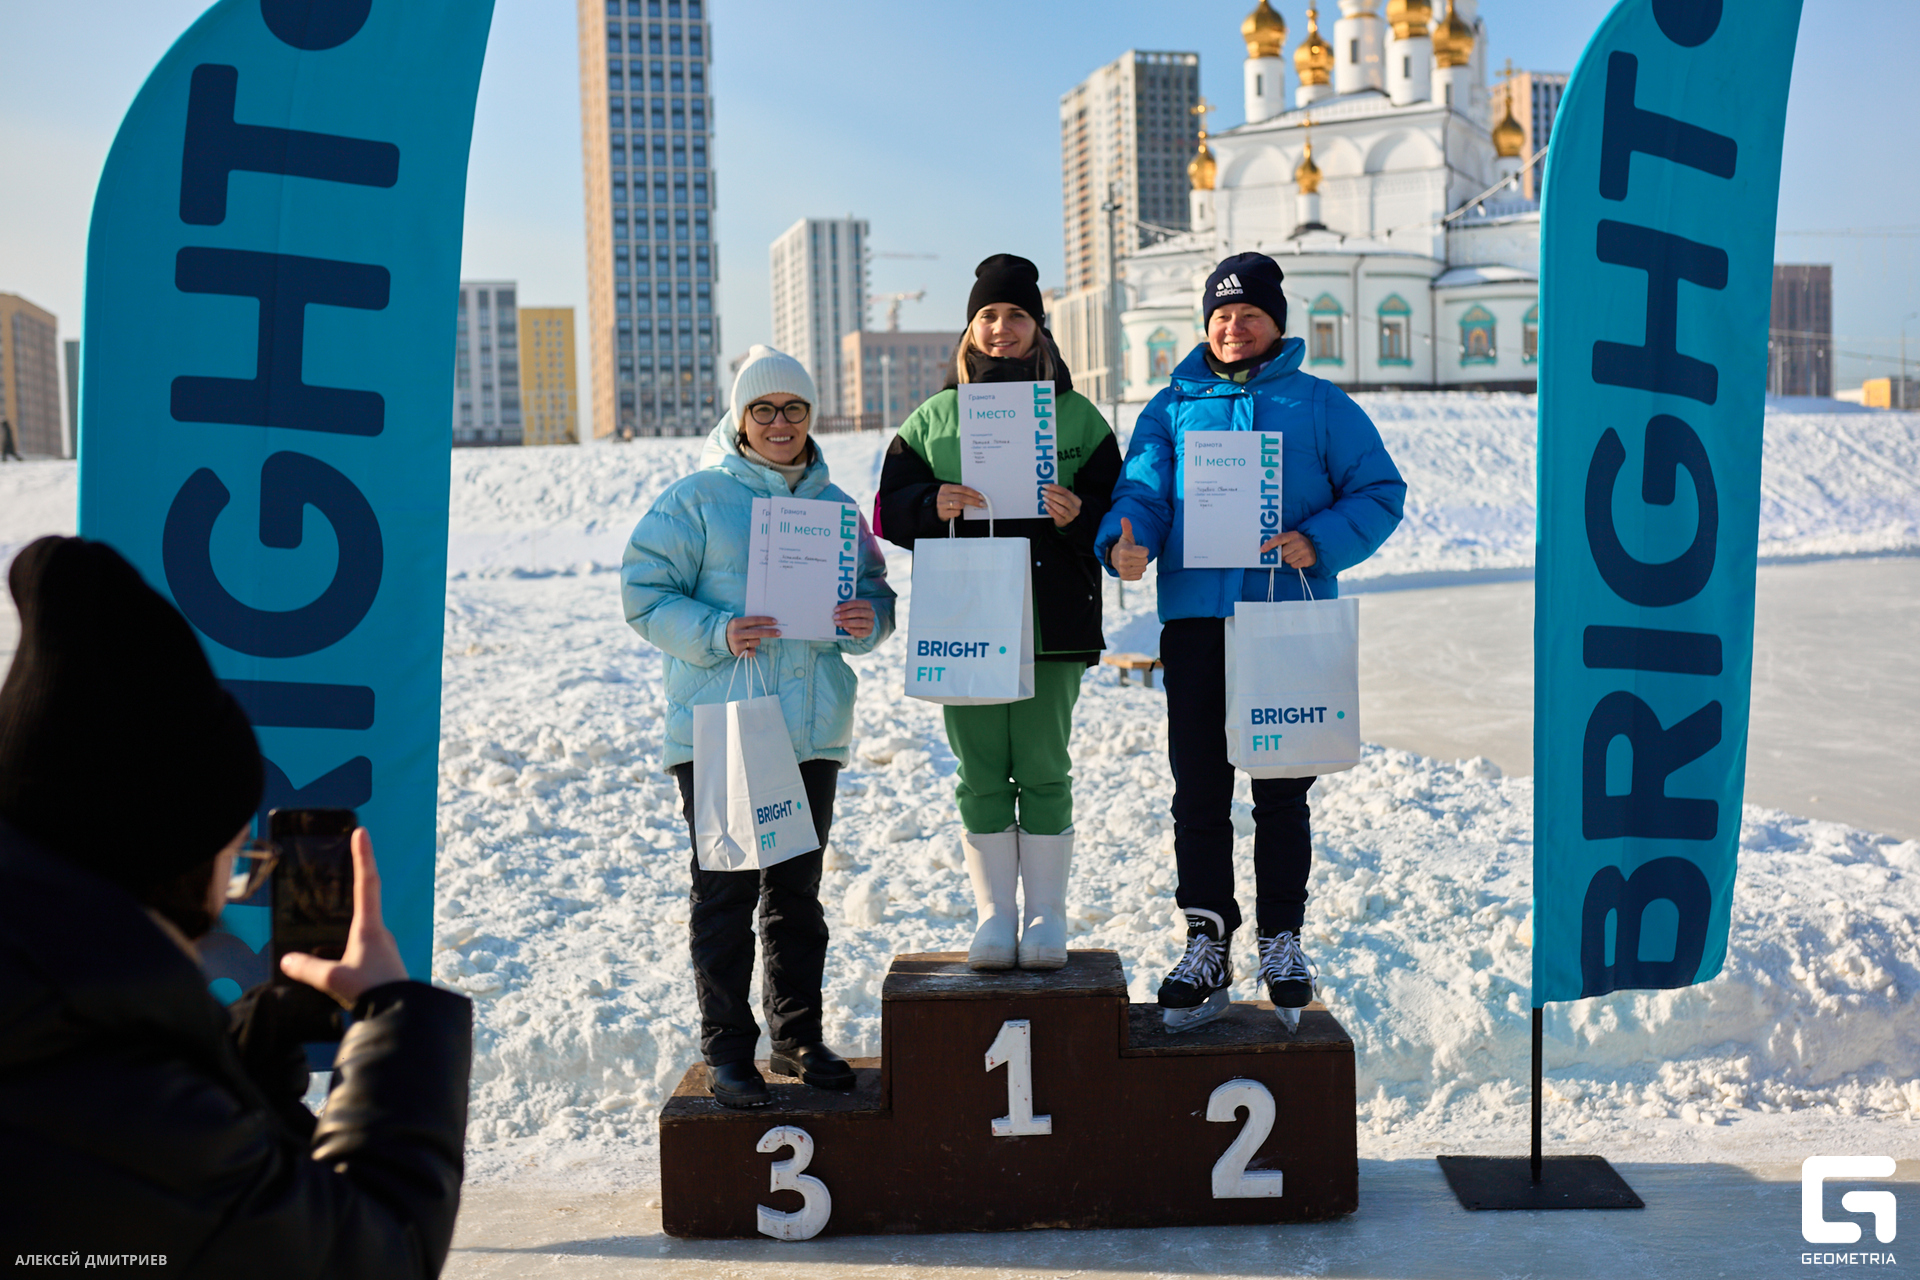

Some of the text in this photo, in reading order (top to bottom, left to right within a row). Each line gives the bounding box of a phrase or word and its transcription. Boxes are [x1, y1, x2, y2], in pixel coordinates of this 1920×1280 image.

[1215, 288, 1244, 298] adidas
[1033, 383, 1052, 418] FIT
[976, 409, 1016, 420] место
[1261, 433, 1279, 468] FIT
[1206, 457, 1246, 467] место
[780, 507, 807, 516] Грамота
[794, 526, 831, 537] место
[840, 504, 857, 540] FIT
[1580, 50, 1738, 998] BRIGHT
[917, 640, 990, 658] BRIGHT
[917, 667, 946, 682] FIT
[1251, 707, 1327, 725] BRIGHT
[1252, 734, 1283, 751] FIT
[756, 800, 792, 825] BRIGHT
[760, 831, 776, 851] FIT
[984, 1019, 1053, 1137] 1
[1206, 1079, 1284, 1199] 2
[755, 1125, 832, 1241] 3
